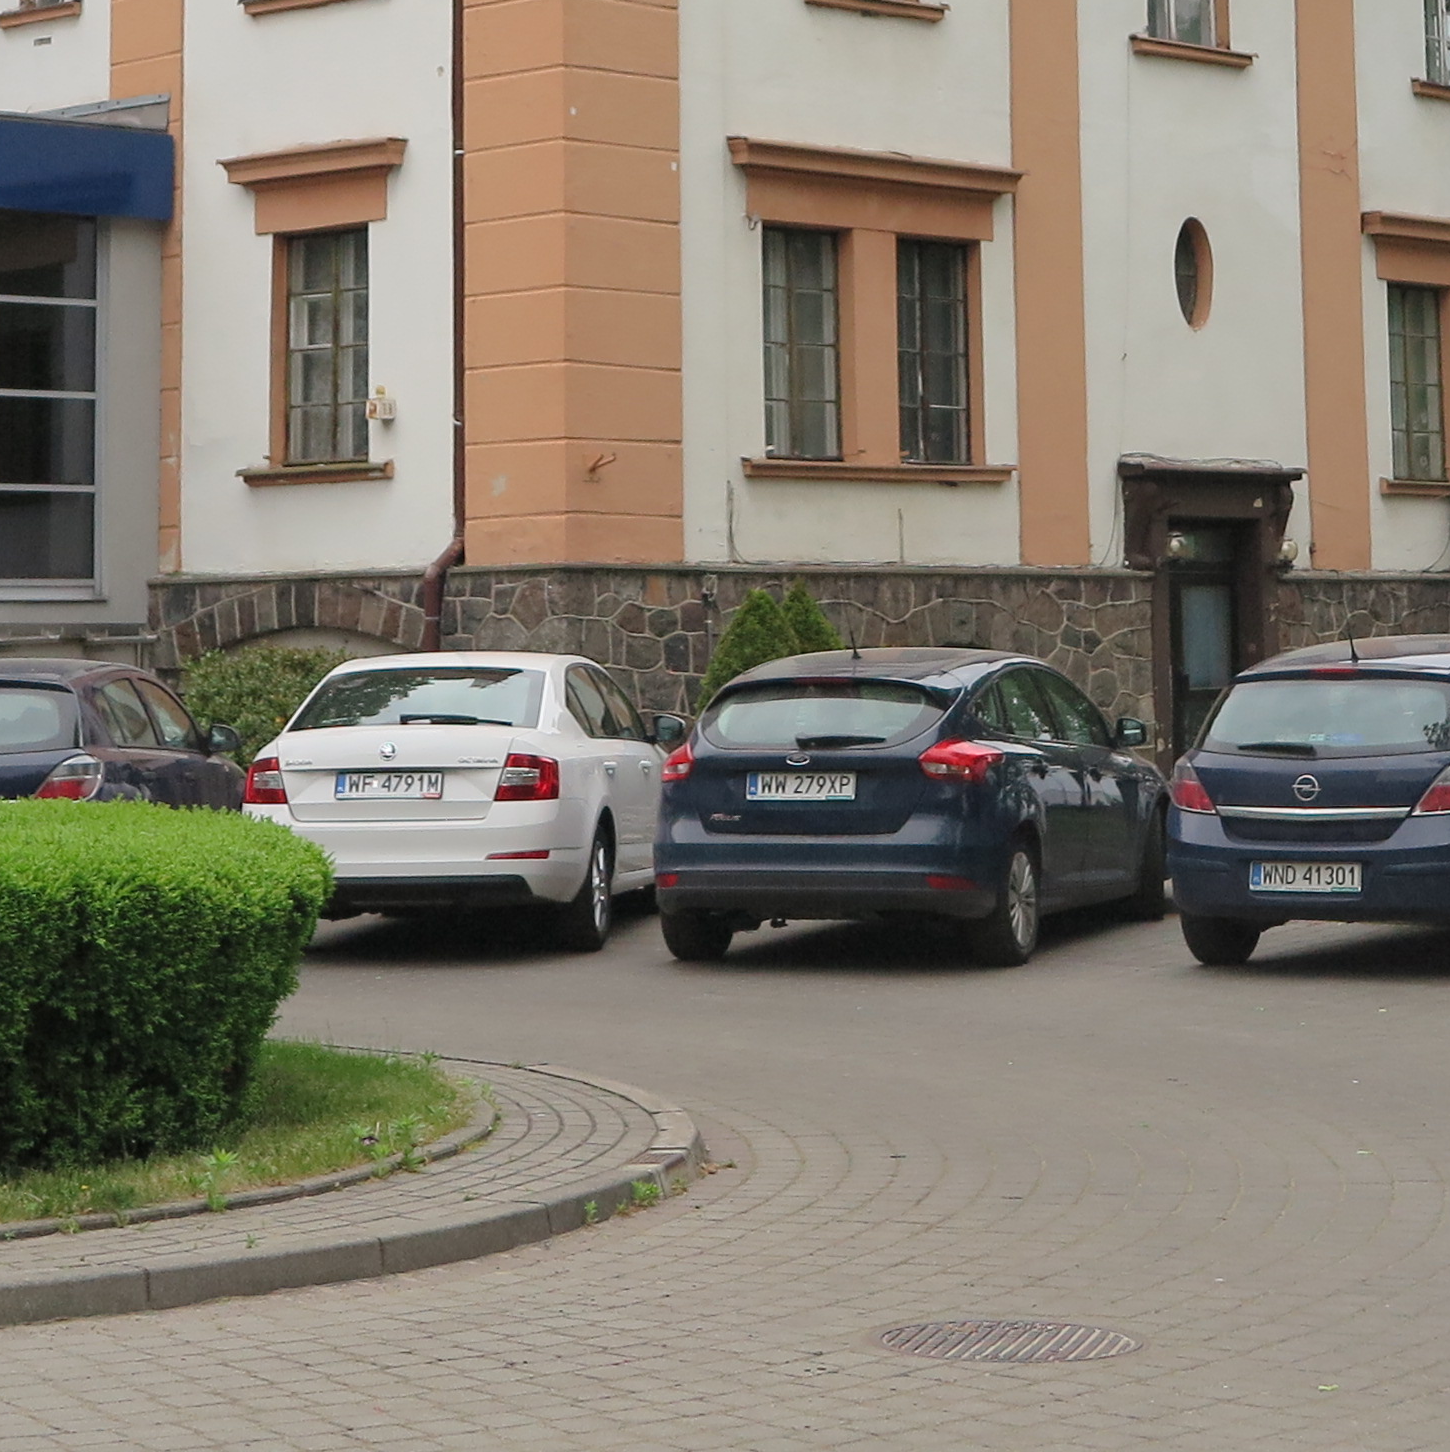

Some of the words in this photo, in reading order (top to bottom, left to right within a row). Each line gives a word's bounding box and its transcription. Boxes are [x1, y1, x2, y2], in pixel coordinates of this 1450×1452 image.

[349, 774, 373, 793] WF
[381, 773, 439, 793] 4791M
[760, 776, 787, 794] WW
[793, 775, 850, 794] 279XP
[1263, 865, 1296, 885] WND
[1302, 866, 1355, 886] 41301
